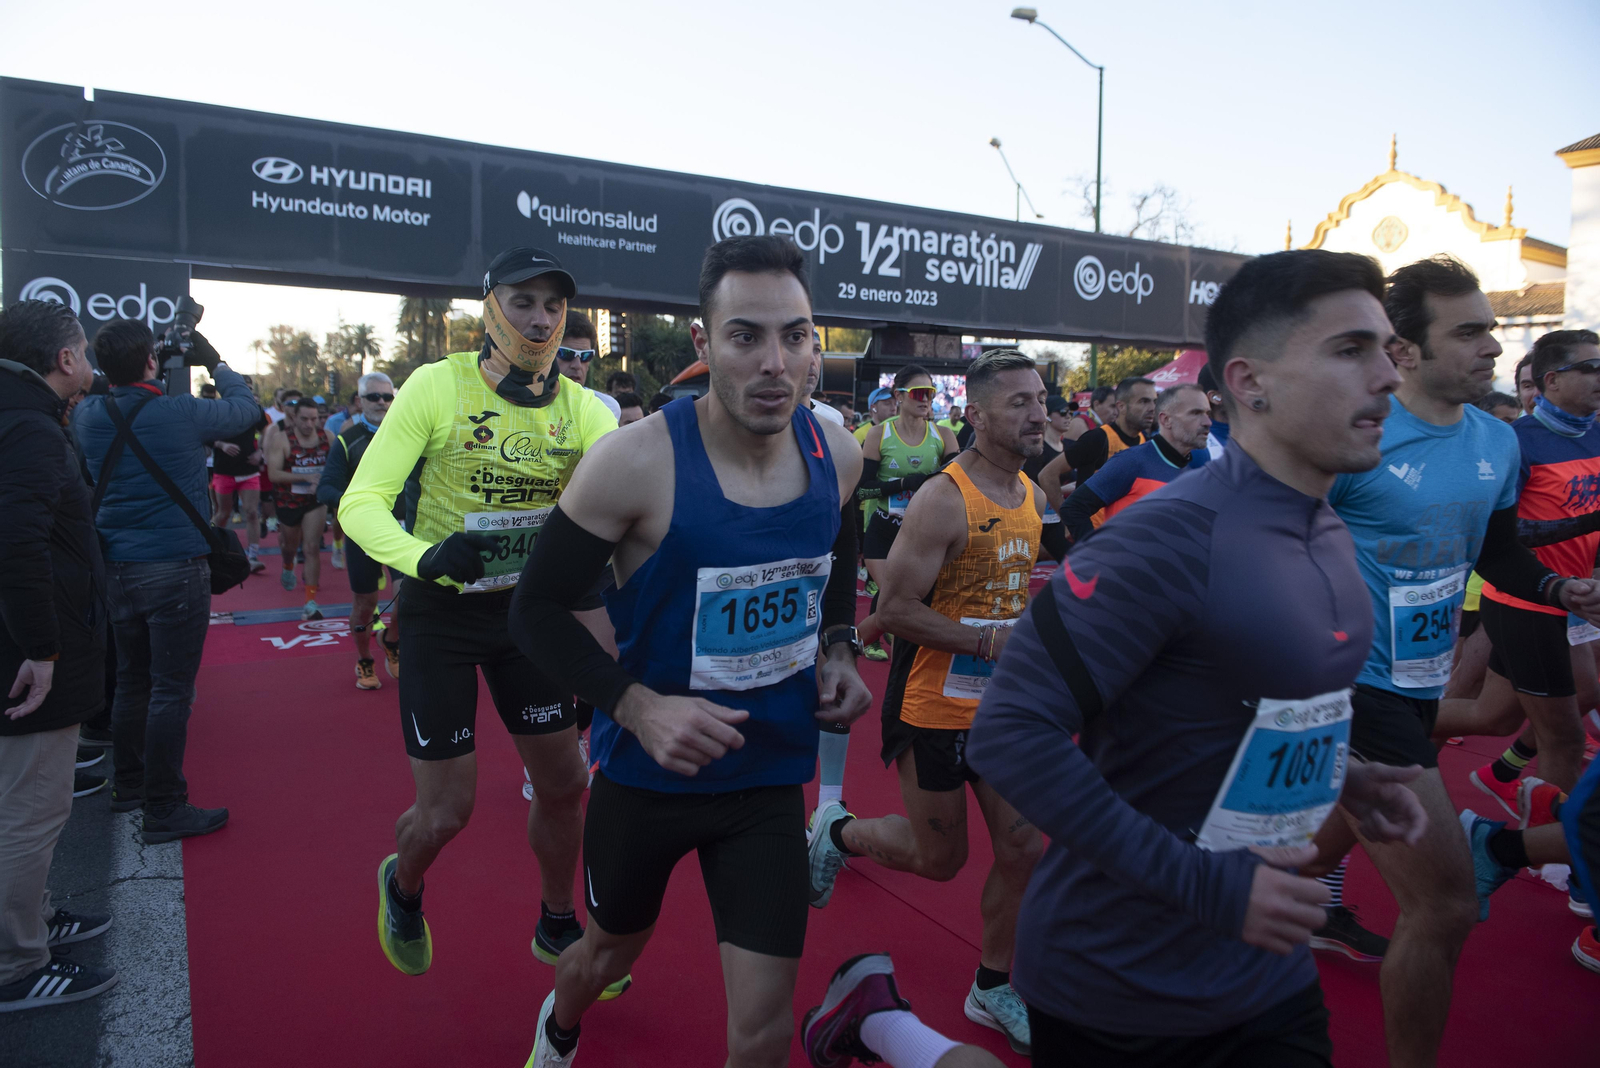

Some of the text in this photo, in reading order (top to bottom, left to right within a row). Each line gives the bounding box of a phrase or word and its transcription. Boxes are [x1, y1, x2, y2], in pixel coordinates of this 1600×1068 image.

[100, 157, 141, 176] Canarias
[310, 164, 432, 199] HYUNDAI
[251, 190, 431, 226] Hyundauto Motor
[557, 231, 657, 253] Healthcare Partner
[768, 207, 845, 265] edp
[896, 225, 1016, 264] maratón
[925, 254, 1017, 290] sevilla
[1107, 261, 1154, 305] edp
[86, 282, 176, 334] edp
[838, 282, 938, 306] 29 enero 2023
[490, 516, 509, 528] edp
[734, 571, 759, 587] edp
[773, 562, 814, 574] maratón
[1394, 569, 1413, 579] WE
[1415, 569, 1437, 579] ARE
[721, 586, 799, 635] 1655
[730, 645, 759, 654] Alberto
[762, 649, 782, 663] edp
[1266, 735, 1334, 788] 1087
